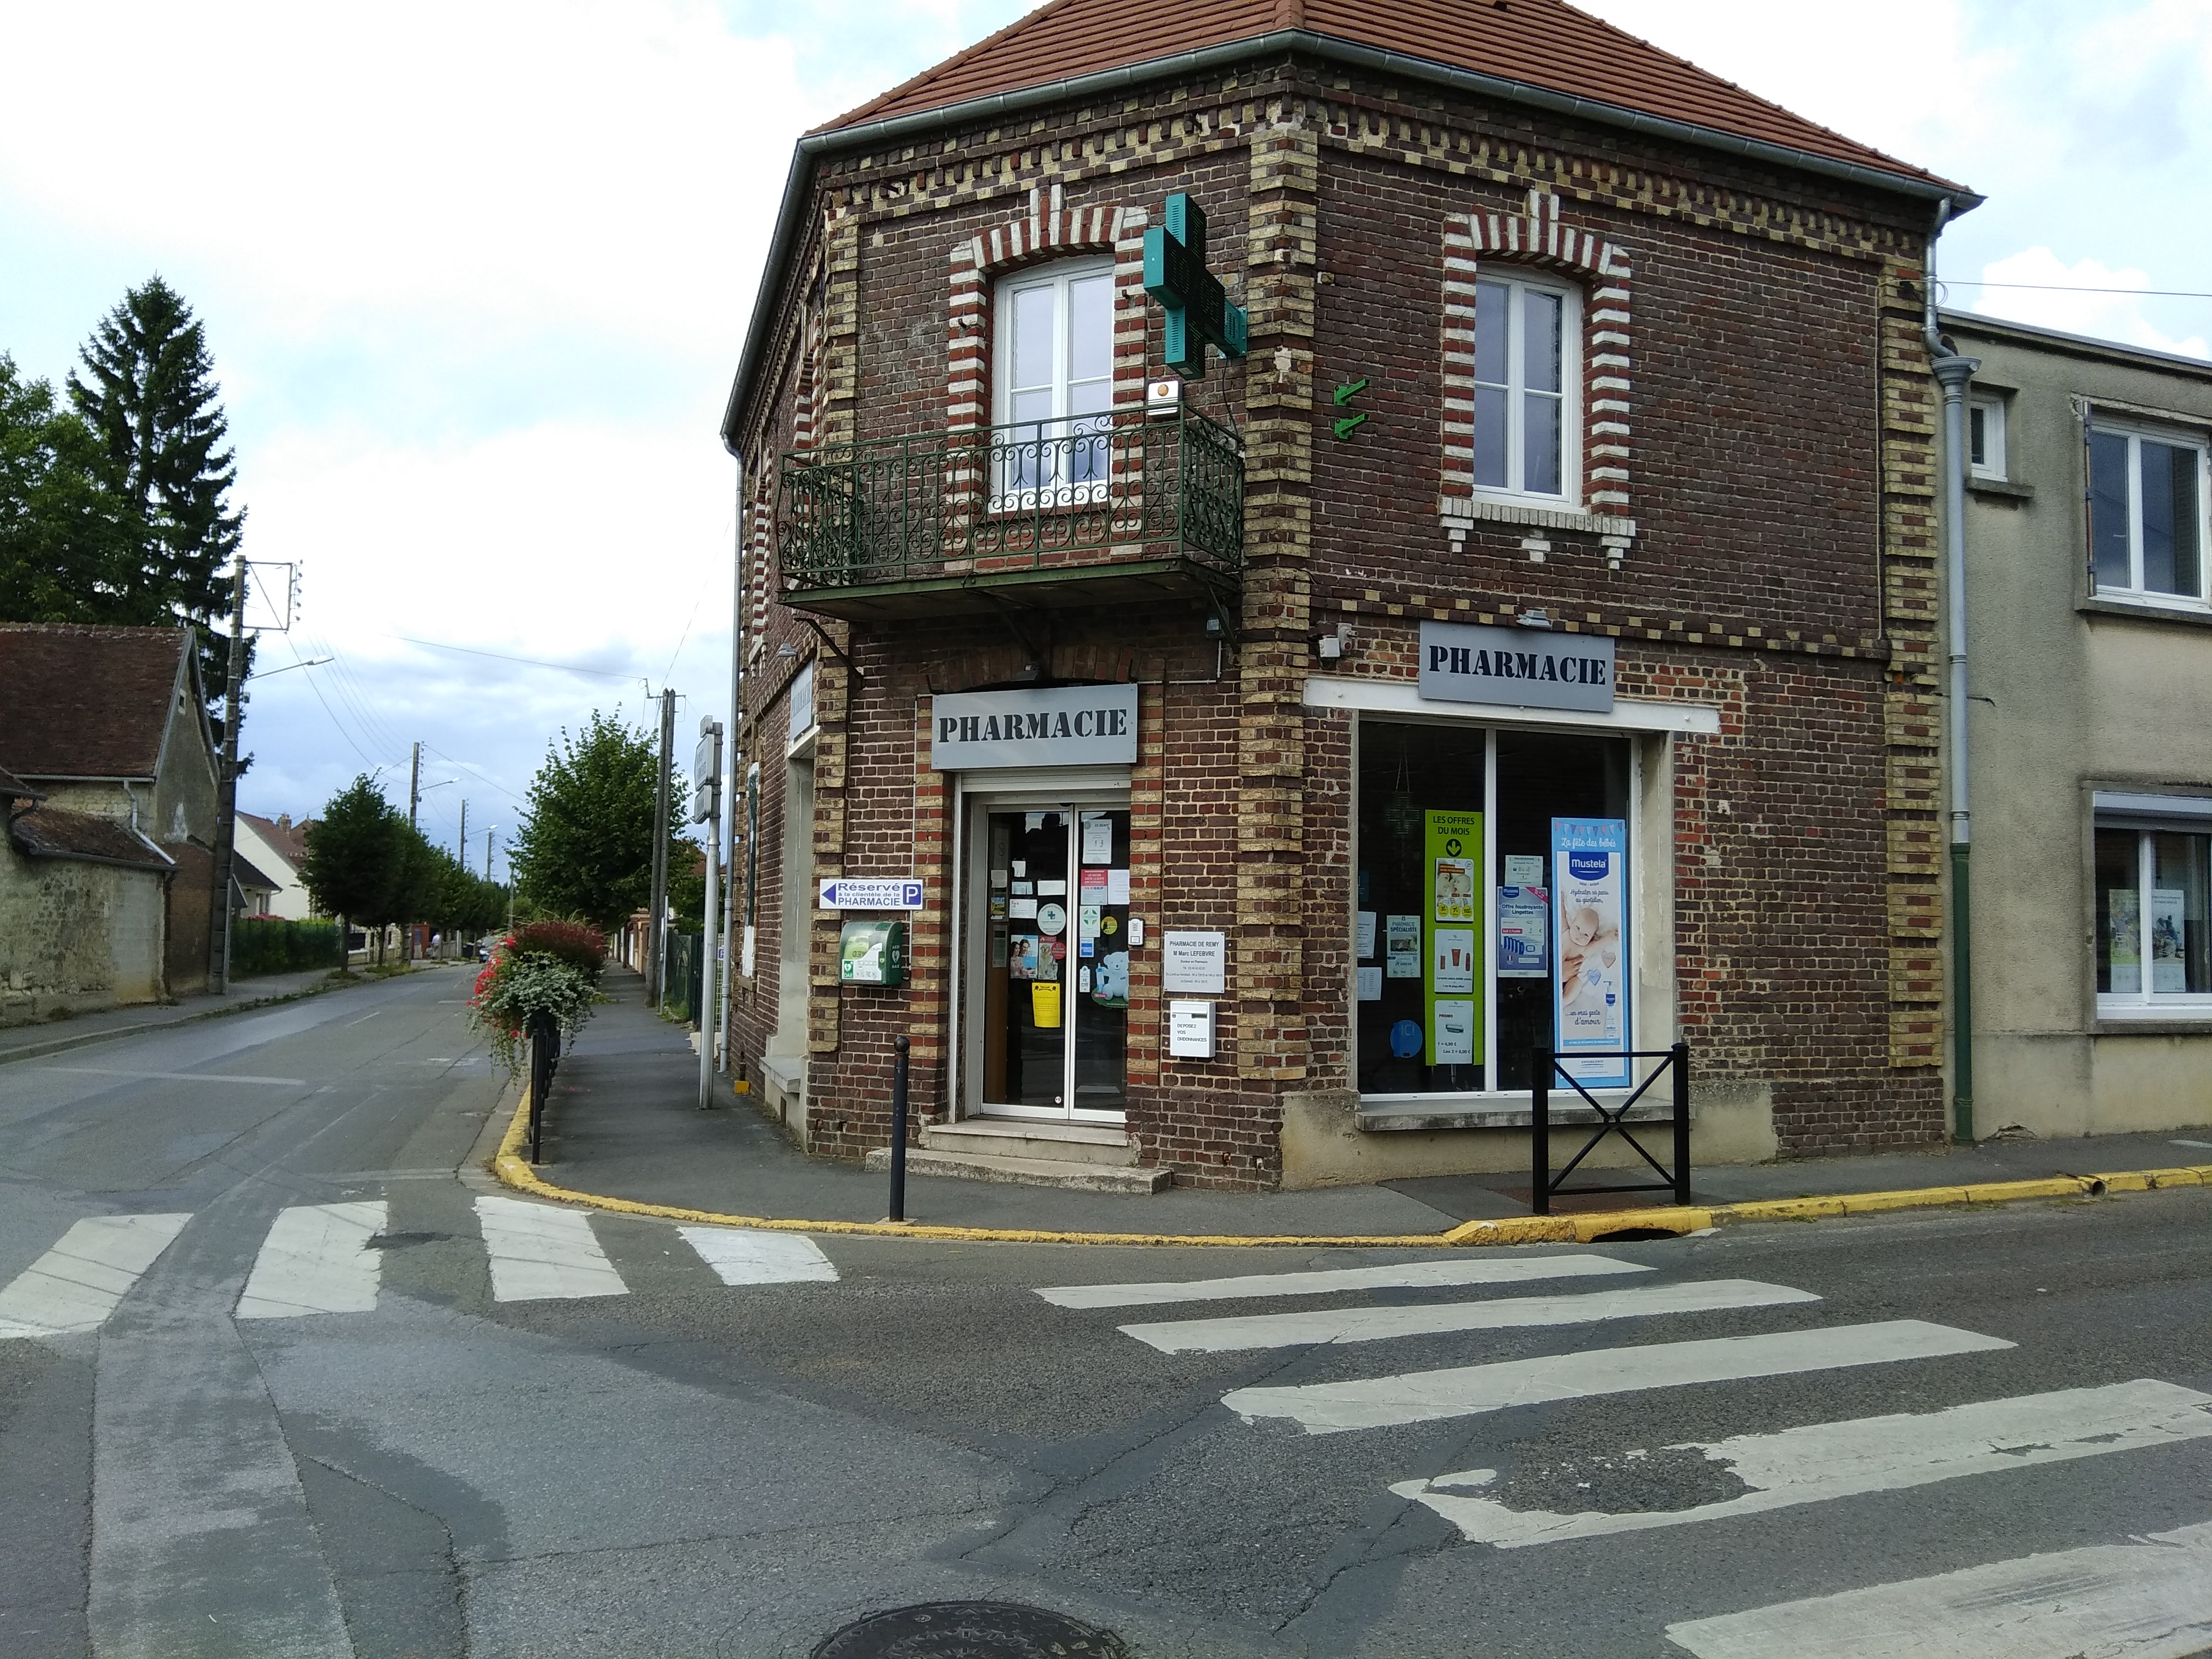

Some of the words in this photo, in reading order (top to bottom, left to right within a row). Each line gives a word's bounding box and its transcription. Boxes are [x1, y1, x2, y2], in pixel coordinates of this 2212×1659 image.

[1429, 644, 1606, 685] PHARMACIE
[938, 708, 1127, 743] PHARMACIE
[1447, 816, 1474, 825] OFFRES
[1561, 837, 1572, 848] La
[1572, 837, 1585, 849] fête
[1586, 837, 1597, 847] des
[1599, 837, 1616, 848] bébés
[838, 883, 900, 891] Réservé
[906, 886, 918, 903] P
[1570, 889, 1591, 897] Hydrater
[1574, 1017, 1601, 1025] d'amour
